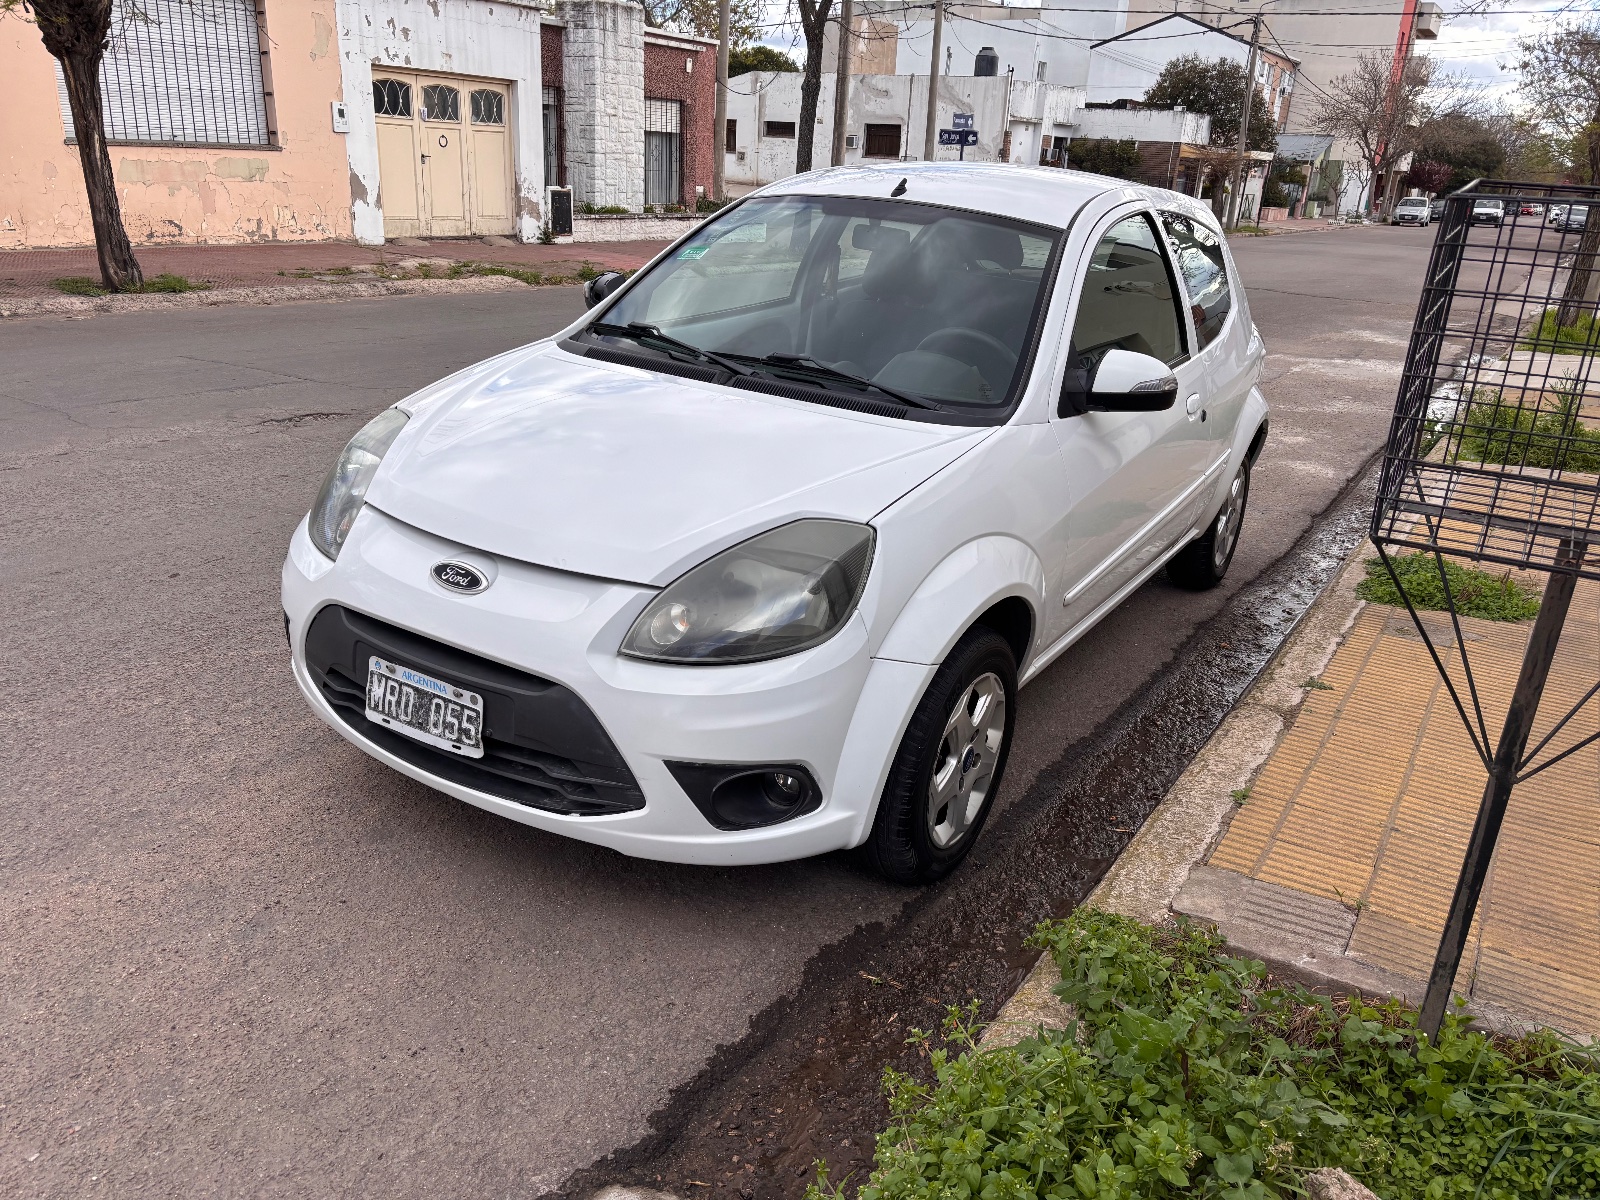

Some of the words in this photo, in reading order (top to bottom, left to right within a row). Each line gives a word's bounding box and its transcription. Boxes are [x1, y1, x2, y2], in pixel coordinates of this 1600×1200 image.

[441, 566, 472, 586] Ford
[401, 670, 448, 695] ARGENTINA
[429, 697, 477, 745] 055
